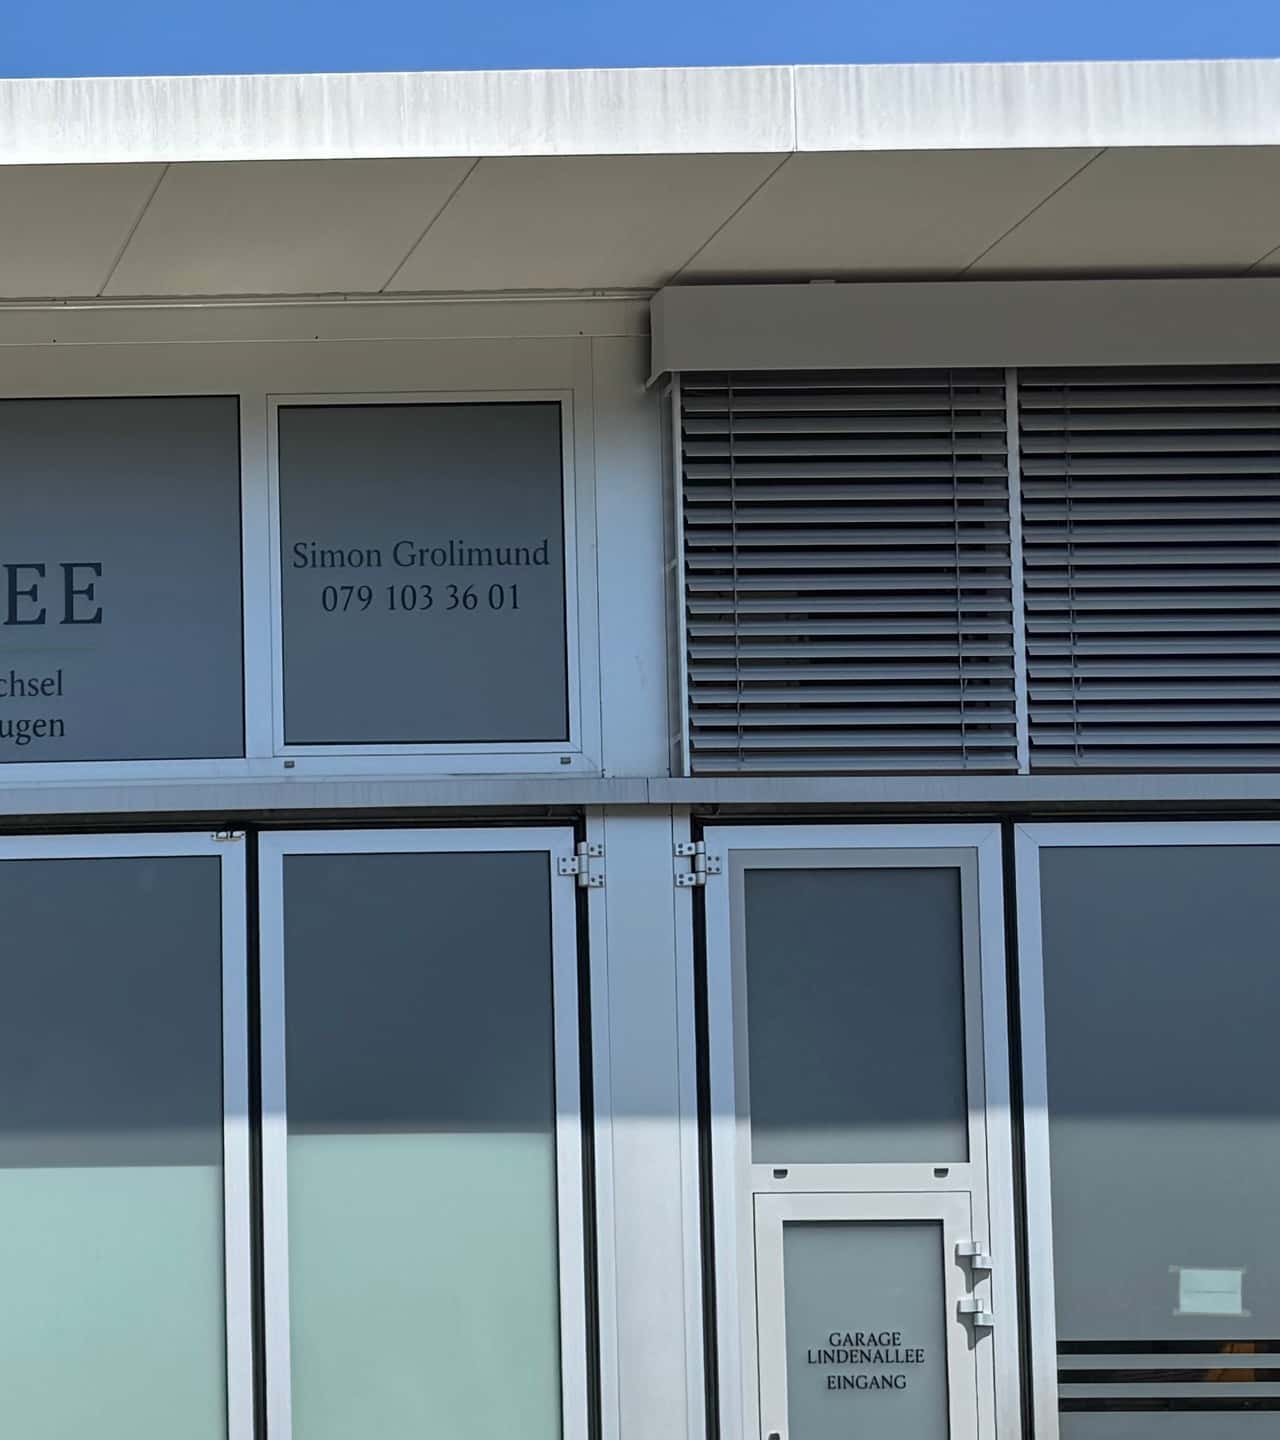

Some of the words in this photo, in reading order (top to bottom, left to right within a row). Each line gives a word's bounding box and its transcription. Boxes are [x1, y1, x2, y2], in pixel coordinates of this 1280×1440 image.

[293, 541, 382, 569] Simon
[393, 538, 550, 567] Grolimund
[321, 585, 373, 612] 079
[387, 584, 433, 611] 103
[446, 583, 478, 611] 36
[489, 583, 519, 610] 01
[828, 1331, 902, 1347] GARAGE
[807, 1348, 926, 1365] LINDENALLEE
[826, 1374, 907, 1390] EINGANG
